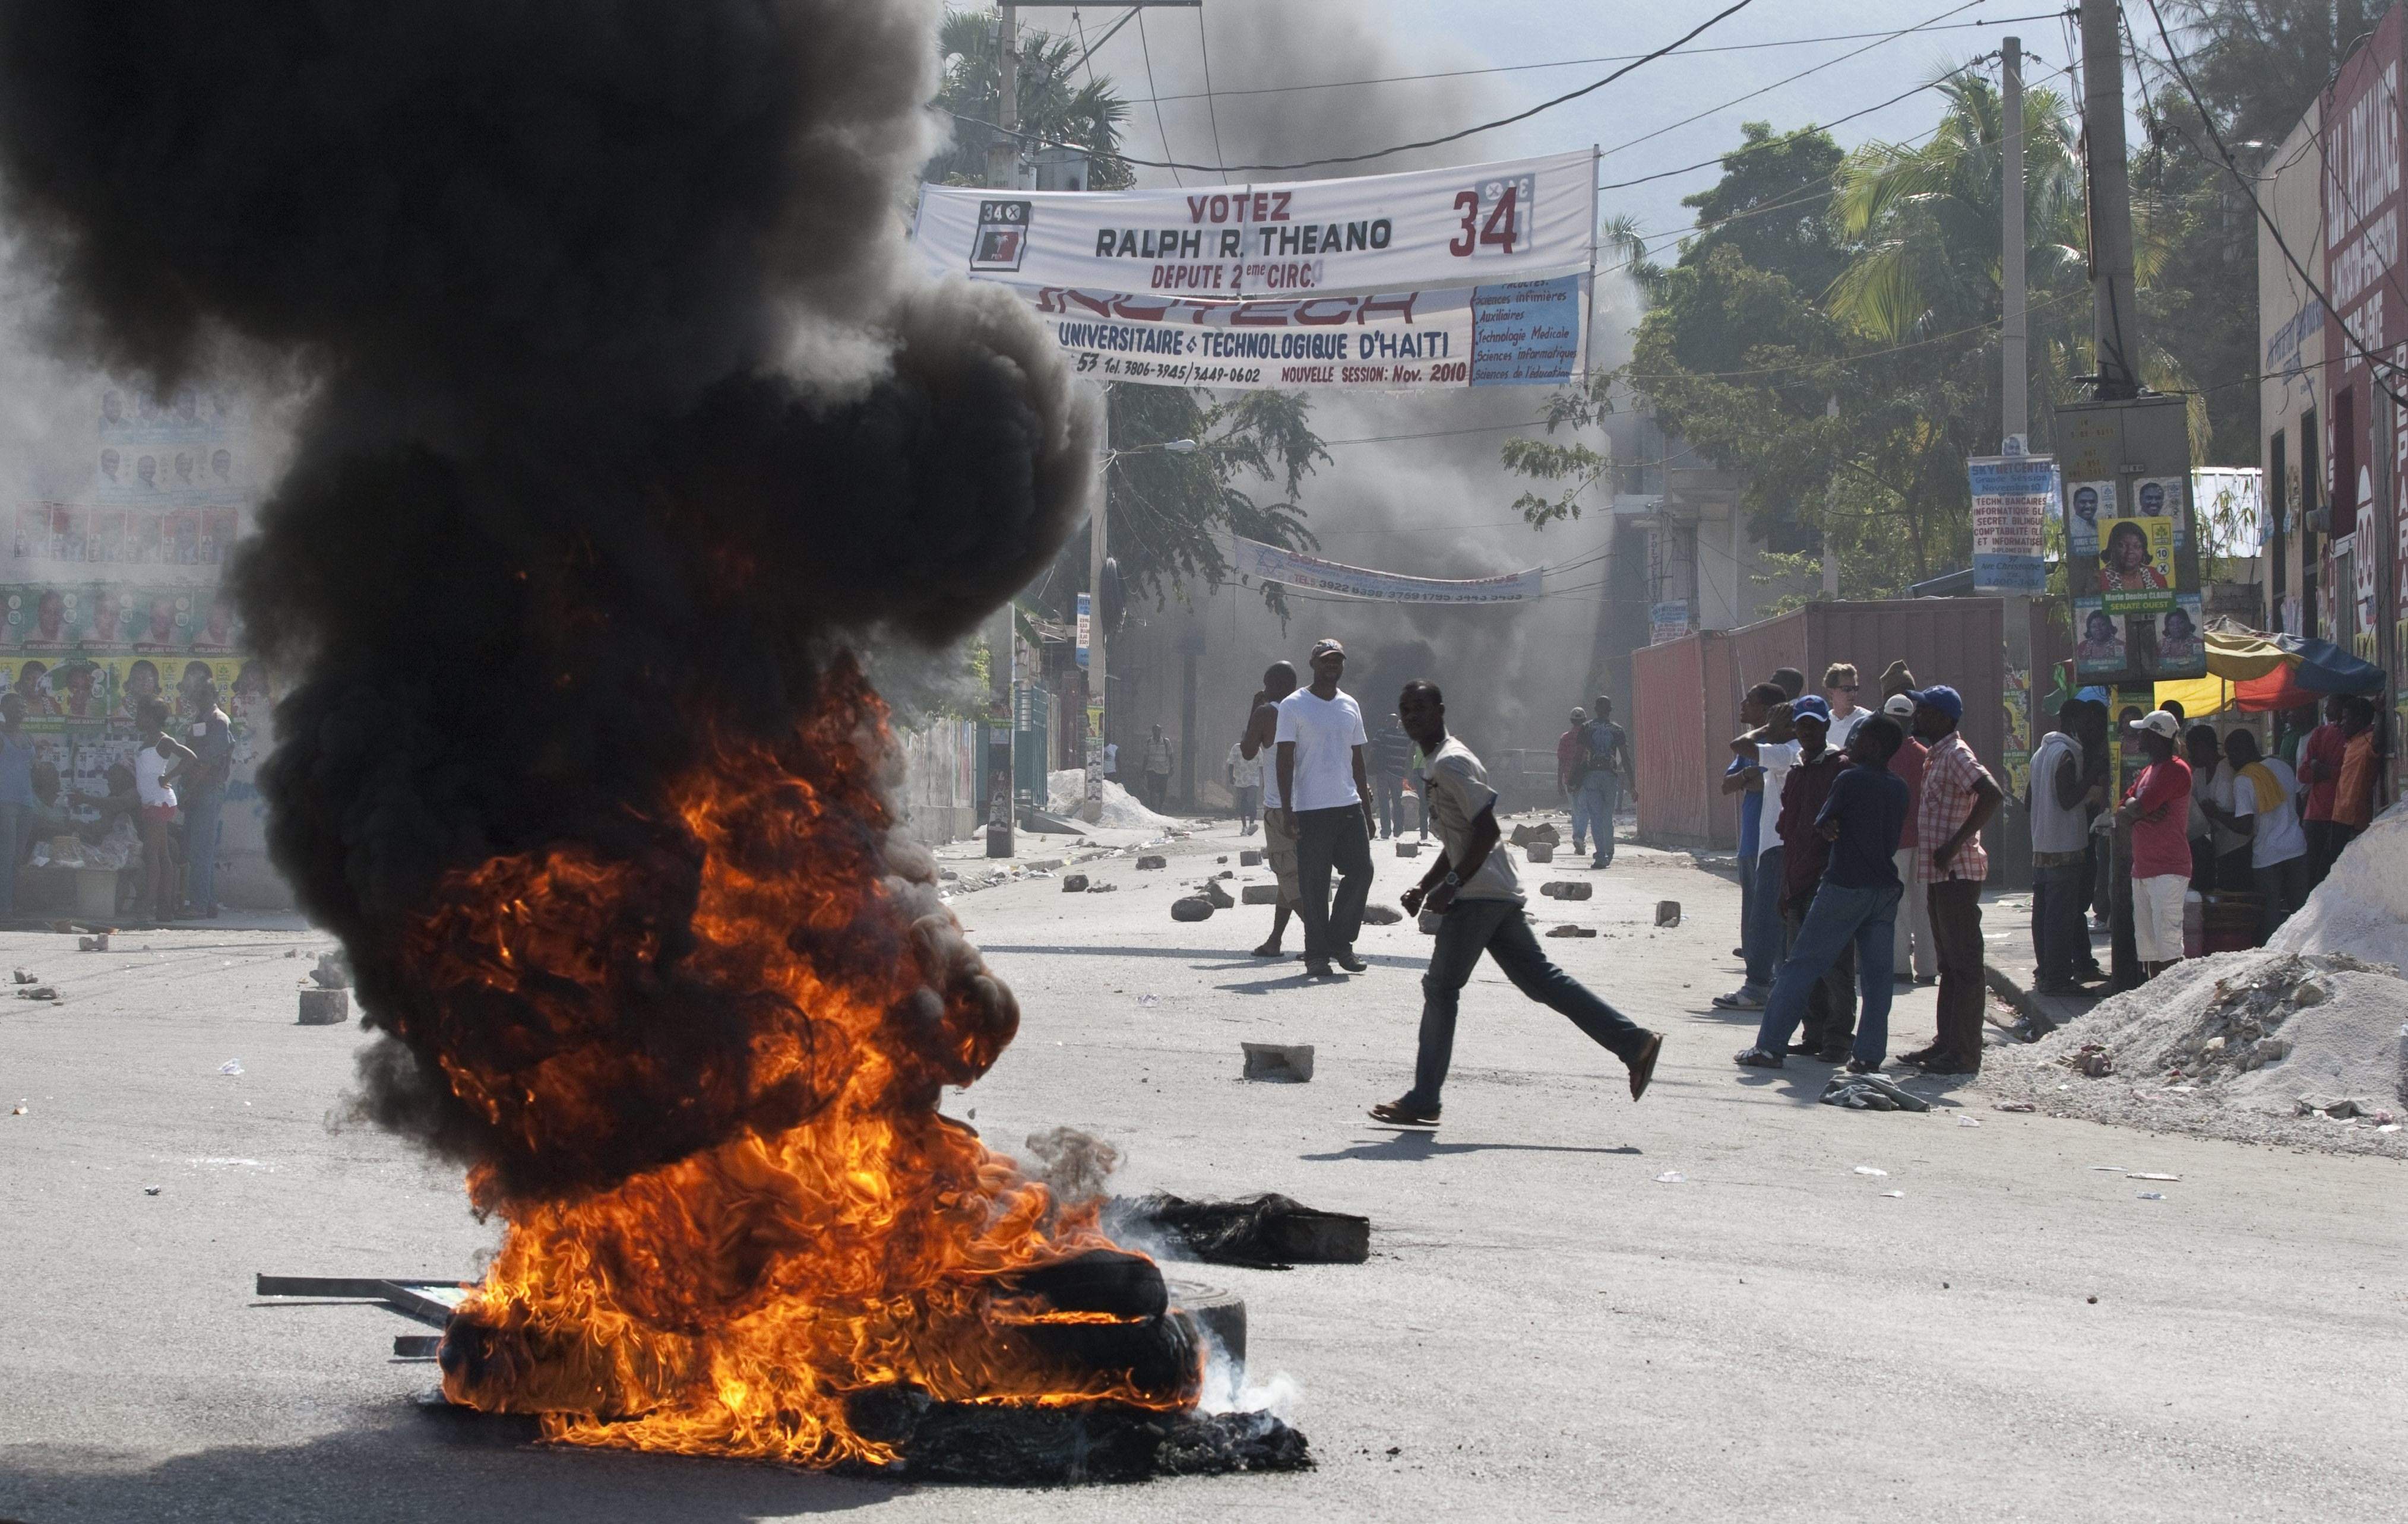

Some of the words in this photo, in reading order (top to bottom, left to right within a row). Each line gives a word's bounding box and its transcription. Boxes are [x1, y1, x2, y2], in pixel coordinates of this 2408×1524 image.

[983, 203, 1002, 221] 34
[1187, 191, 1292, 224] VOTEZ
[1449, 186, 1517, 257] 34
[1096, 229, 1202, 259] RALPH
[1219, 229, 1245, 258] R.
[1259, 218, 1392, 256] THEANO
[1151, 264, 1223, 289] DEPUTE
[1267, 262, 1315, 289] CIRC.
[1058, 322, 1185, 355] UNIVERSITAIRE
[1201, 332, 1348, 359] TECHNOLOGIQUE
[1359, 329, 1448, 359] D'HAITI
[1104, 357, 1121, 375] Tel.
[1281, 366, 1334, 383] NOUVELLE
[1341, 366, 1388, 383] SESSION:
[1392, 365, 1422, 382] Nov.
[1429, 362, 1467, 382] 2010
[1512, 365, 1523, 378] de
[1982, 483, 2030, 492] Novembre
[2031, 483, 2041, 491] 10
[2005, 497, 2047, 505] BANCAIRES
[1973, 506, 2029, 516] INFORMATIQUE
[1977, 537, 1988, 546] ET
[2156, 549, 2167, 557] 10
